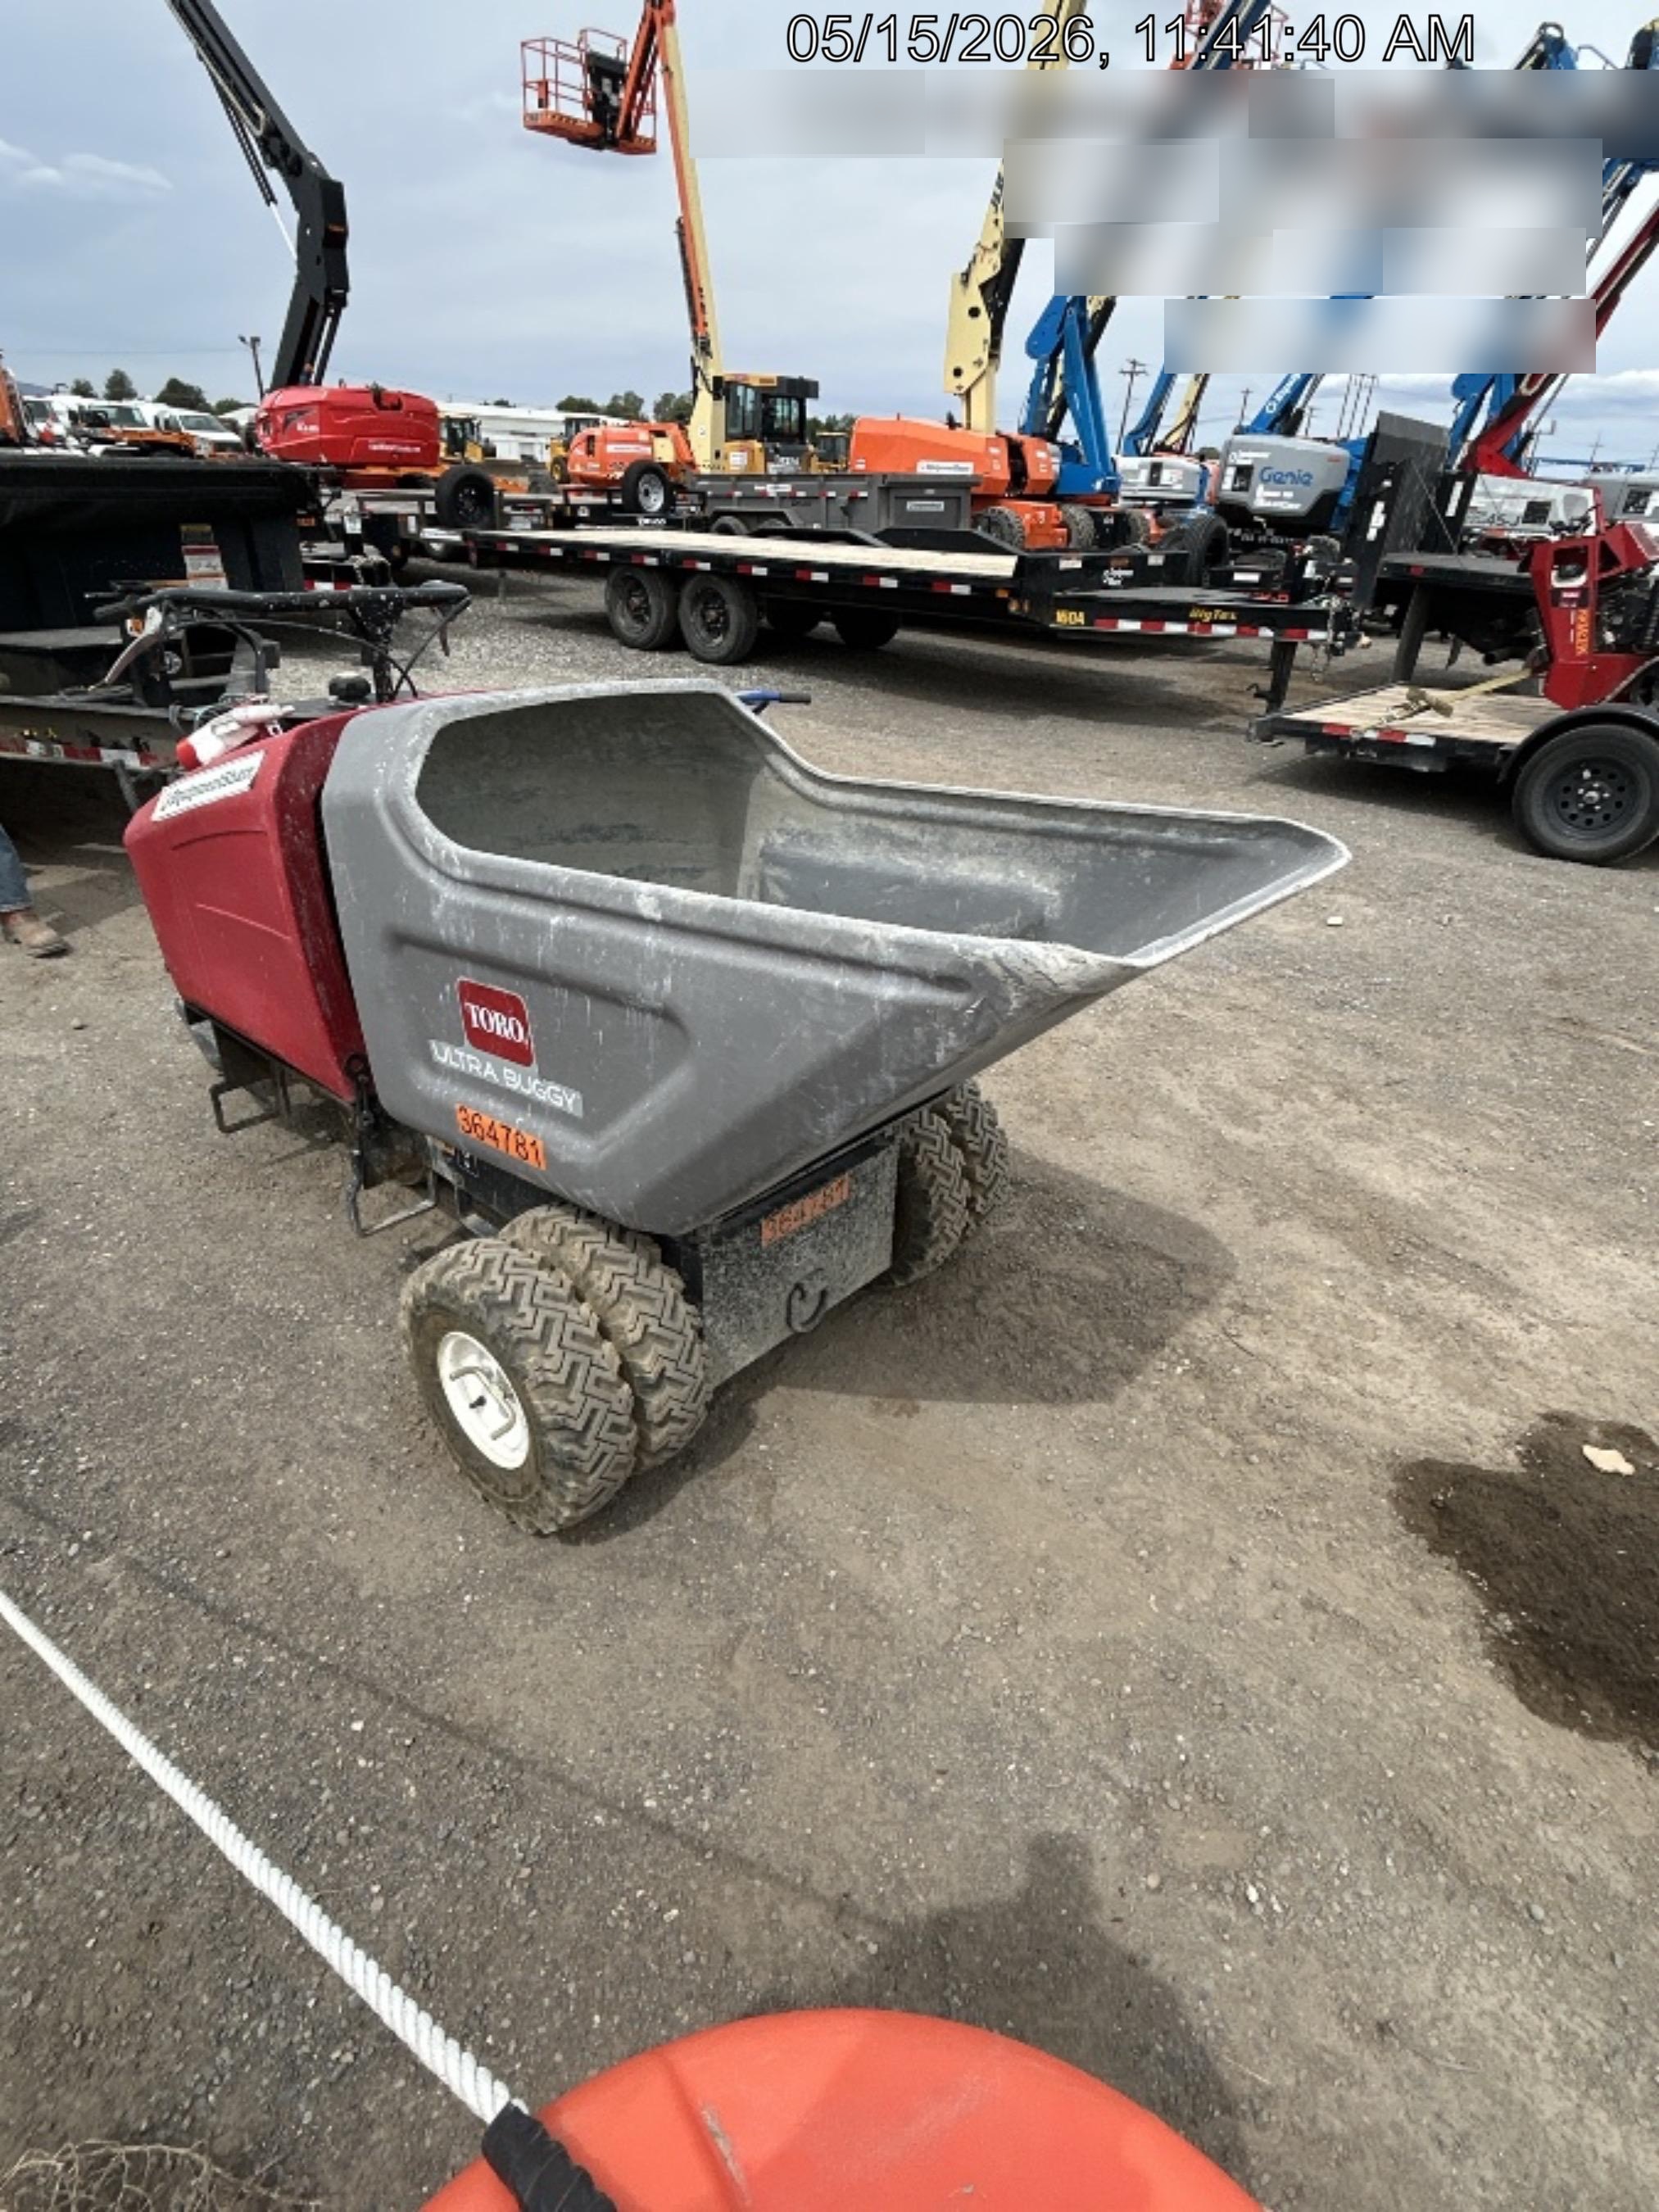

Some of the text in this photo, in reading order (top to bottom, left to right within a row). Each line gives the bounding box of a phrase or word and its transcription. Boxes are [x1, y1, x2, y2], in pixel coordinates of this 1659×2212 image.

[1259, 466, 1313, 486] Genie
[465, 1002, 525, 1045] TORO
[429, 1040, 581, 1113] ULTRA BUGGY
[458, 1105, 543, 1167] 364781
